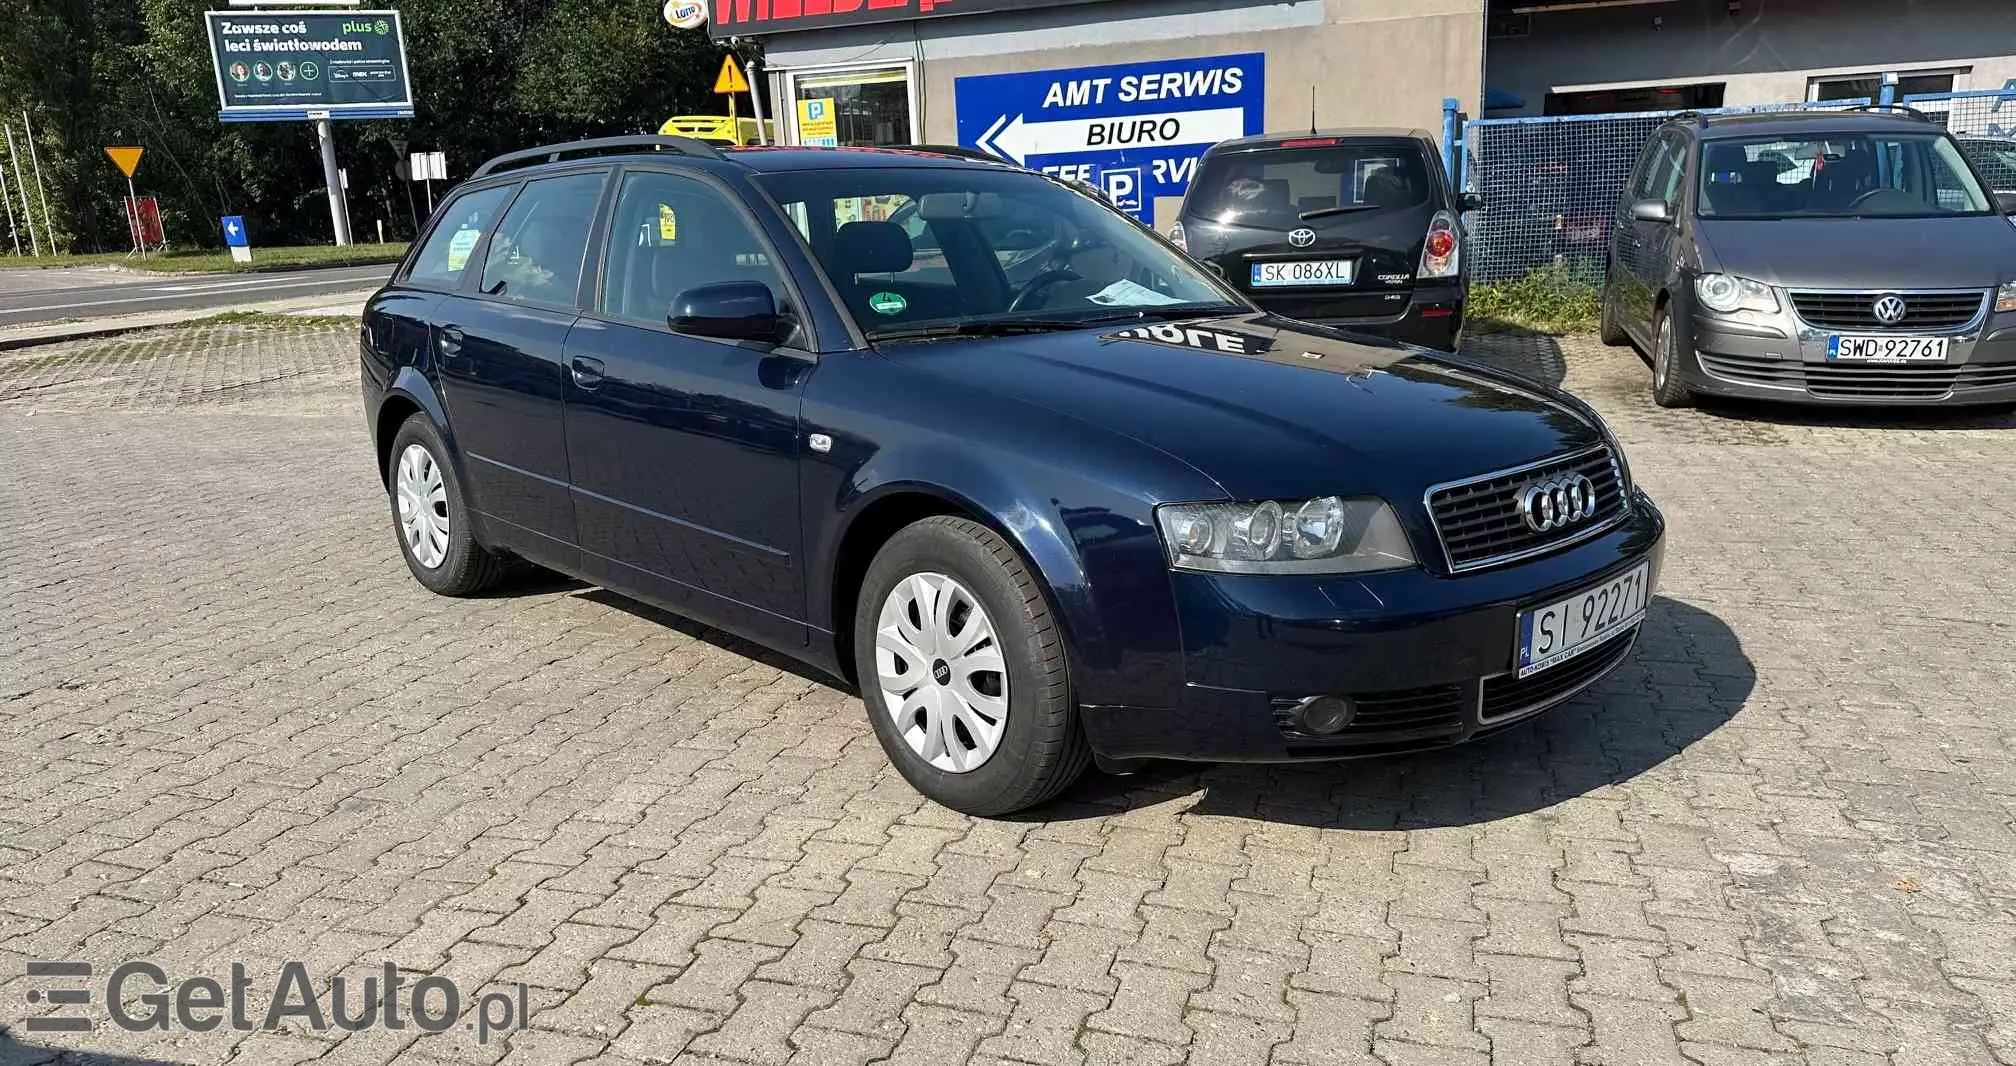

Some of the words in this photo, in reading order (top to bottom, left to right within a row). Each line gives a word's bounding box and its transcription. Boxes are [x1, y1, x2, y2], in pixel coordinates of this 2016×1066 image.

[221, 21, 280, 35] Zawsze
[281, 20, 307, 34] coś
[342, 20, 372, 34] plus
[224, 39, 251, 52] leci
[253, 37, 363, 52] światłowodem
[1042, 78, 1113, 109] AMT
[1118, 67, 1244, 103] SERWIS
[1086, 117, 1181, 146] BIURO
[1108, 174, 1134, 206] P
[1264, 264, 1288, 281] SK
[1292, 260, 1345, 280] 086XL
[1839, 338, 1878, 358] SWD
[1882, 338, 1944, 358] 92761
[1538, 603, 1569, 654] SI
[1580, 569, 1642, 639] 92271
[1520, 646, 1530, 658] PL
